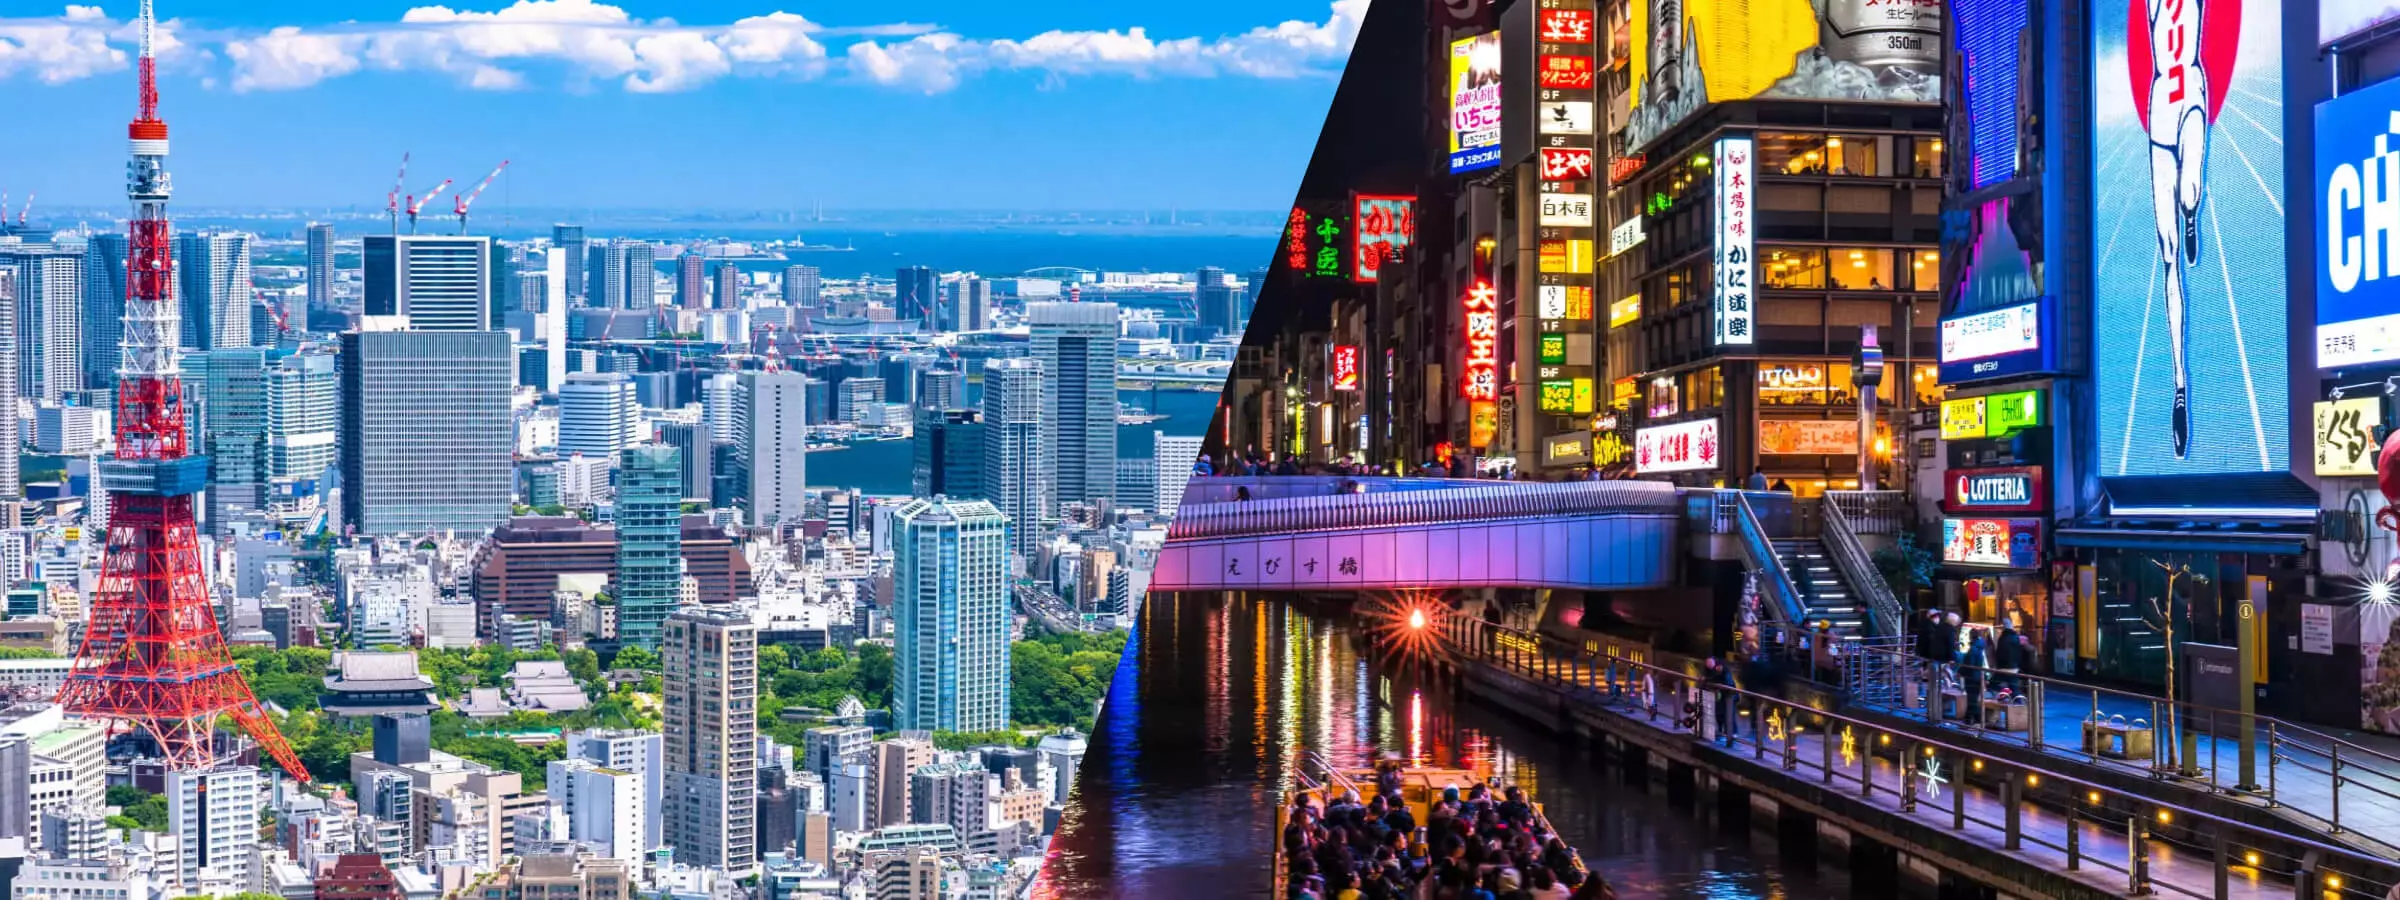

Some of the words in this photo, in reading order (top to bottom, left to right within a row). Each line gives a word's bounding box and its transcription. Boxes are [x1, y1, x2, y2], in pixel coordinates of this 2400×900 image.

[1886, 8, 1920, 20] 生ビール
[1543, 44, 1560, 53] 7F
[1888, 36, 1922, 50] 350ml
[1542, 90, 1560, 99] 6F
[1551, 137, 1565, 146] 5F
[1543, 152, 1588, 177] はや
[1542, 183, 1560, 192] 4F
[1543, 199, 1588, 216] 白木屋
[1729, 171, 1746, 237] 本場の味
[1728, 245, 1748, 336] かに道楽
[1542, 322, 1559, 331] 1F
[1465, 281, 1496, 400] 大阪王将
[2326, 409, 2367, 464] くくる
[1970, 477, 2025, 501] LOTTERIA
[1228, 557, 1357, 576] えびす橋
